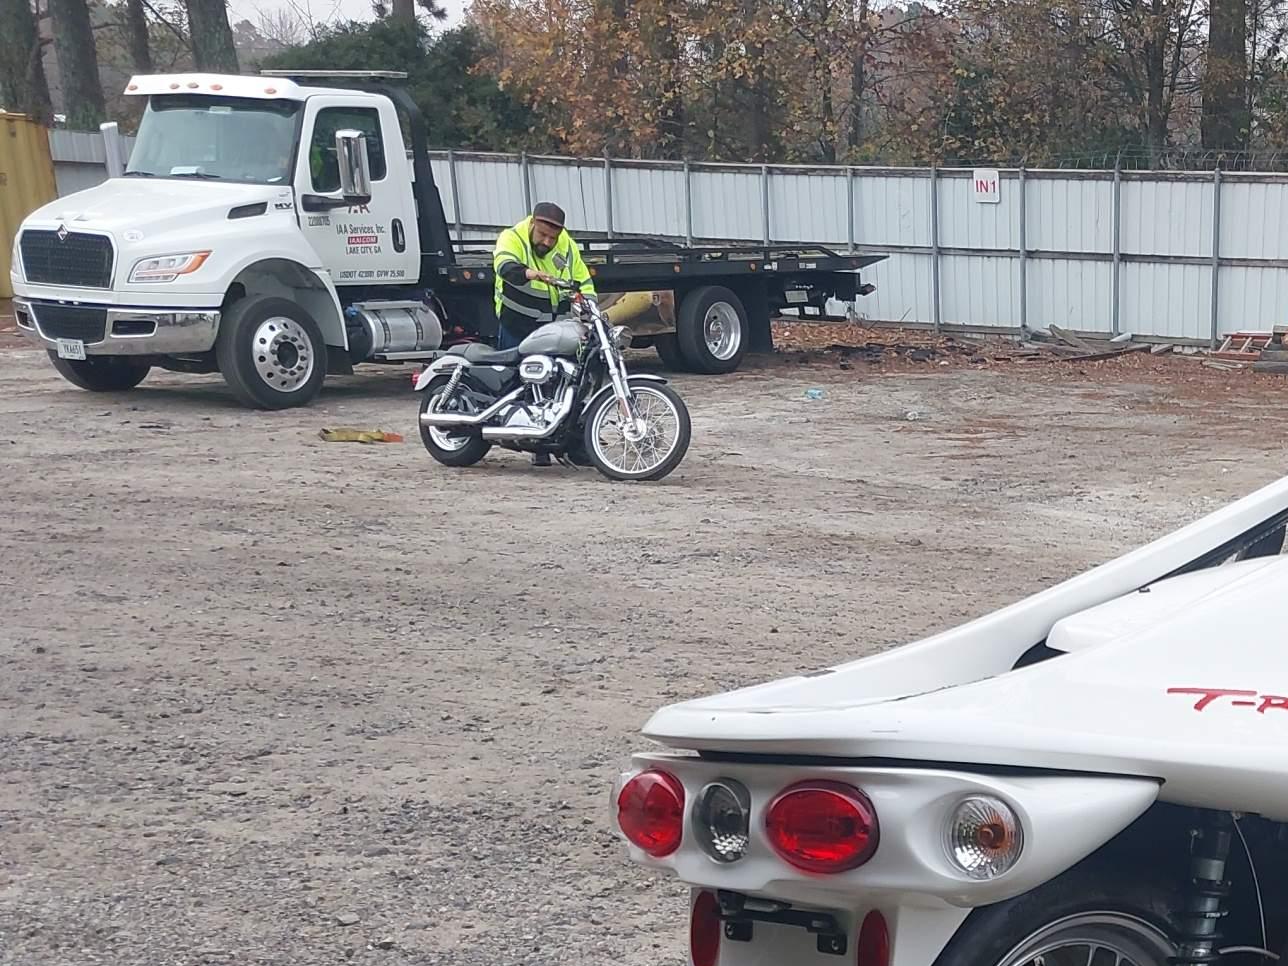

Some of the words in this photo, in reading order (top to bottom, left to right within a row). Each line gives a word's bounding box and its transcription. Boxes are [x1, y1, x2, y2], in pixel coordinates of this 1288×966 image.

[976, 180, 989, 193] IN
[991, 180, 996, 193] 1
[336, 224, 348, 235] IAA
[349, 223, 375, 235] Services,
[346, 246, 360, 255] LAKE
